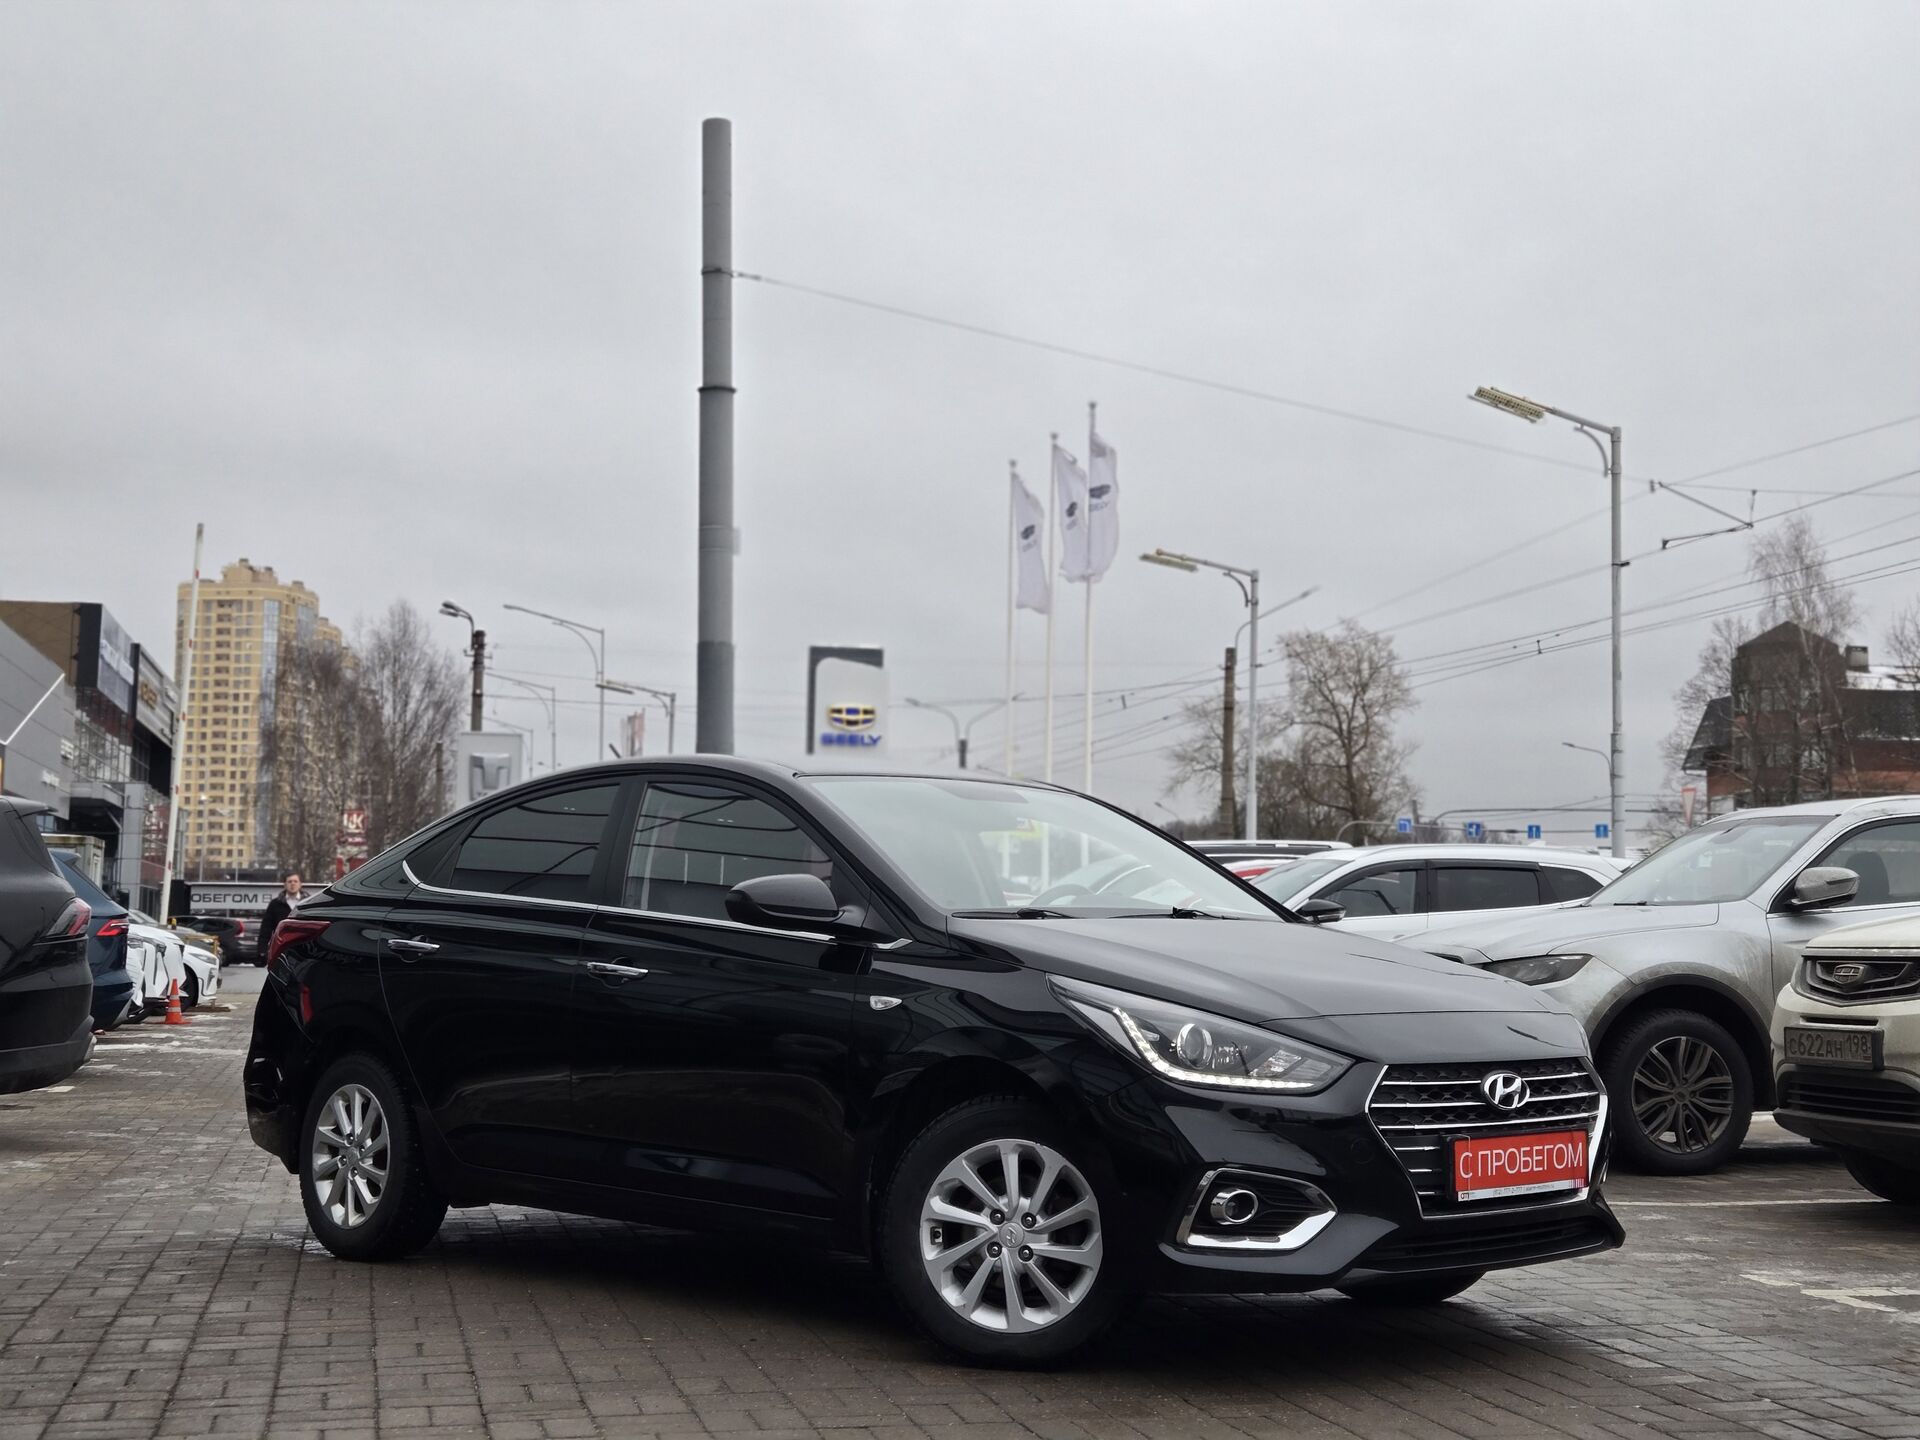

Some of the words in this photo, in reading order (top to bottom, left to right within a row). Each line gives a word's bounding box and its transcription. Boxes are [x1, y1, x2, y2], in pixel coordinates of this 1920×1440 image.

[1789, 1033, 1843, 1058] С622АН
[1845, 1034, 1868, 1055] 198
[1459, 1151, 1473, 1179] С
[1478, 1142, 1583, 1177] ПРОБЕГОМ
